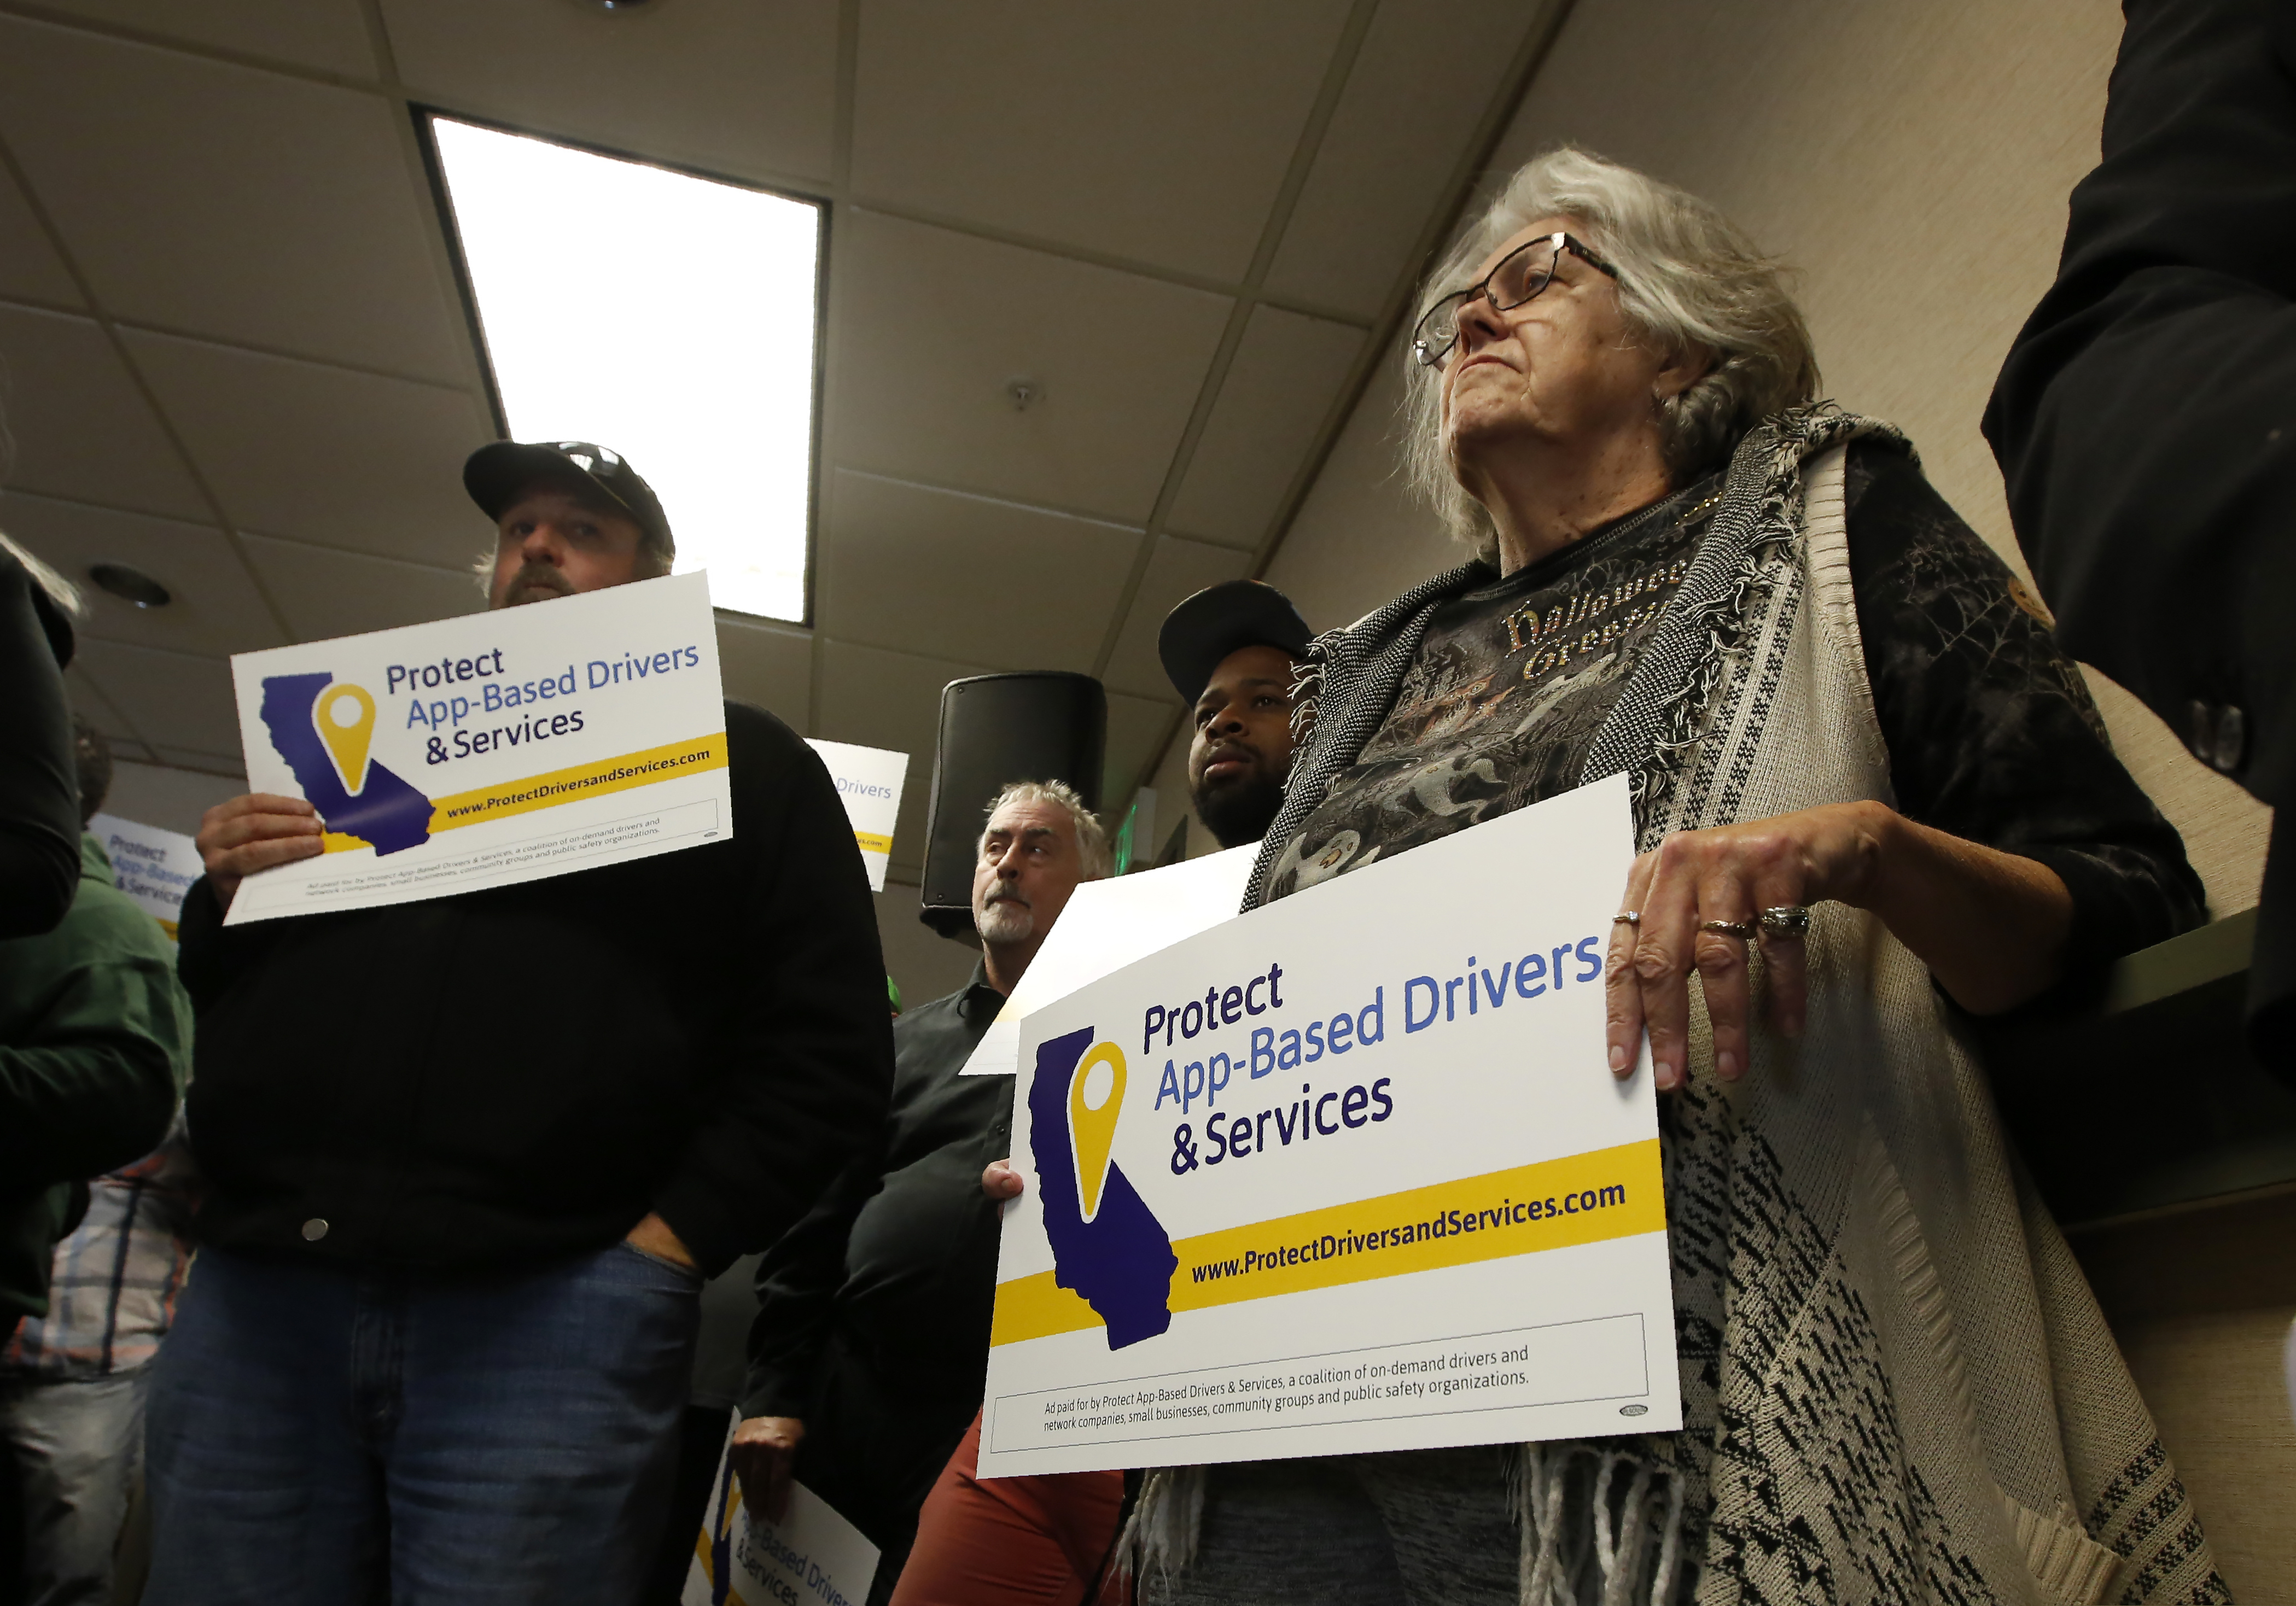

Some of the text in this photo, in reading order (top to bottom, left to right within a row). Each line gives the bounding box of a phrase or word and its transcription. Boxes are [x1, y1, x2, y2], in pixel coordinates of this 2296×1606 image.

[1500, 558, 1687, 659] Hallowee
[1523, 600, 1670, 680] Greeti
[386, 647, 505, 695] Protect
[406, 645, 700, 732] App-Based Drivers
[447, 750, 710, 819] www.ProtectDriversandServices.com
[836, 777, 891, 799] Drivers
[535, 849, 550, 858] and
[552, 843, 576, 856] public
[578, 839, 602, 850] safety
[604, 827, 660, 844] organizations.
[560, 837, 568, 845] of
[569, 828, 615, 844] on-demand
[616, 822, 643, 833] drivers
[644, 817, 660, 827] and
[1143, 962, 1284, 1055] Protect
[1154, 936, 1602, 1115] App-Based Drivers
[1192, 1184, 1625, 1283] www.ProtectDriversandServices.com
[1044, 1344, 1528, 1417] Ad paid for by Protect App-Based Drivers & Services, a coalition of on-demand drivers and
[1044, 1370, 1529, 1432] network companies, small businesses, community groups and public safety organizations.
